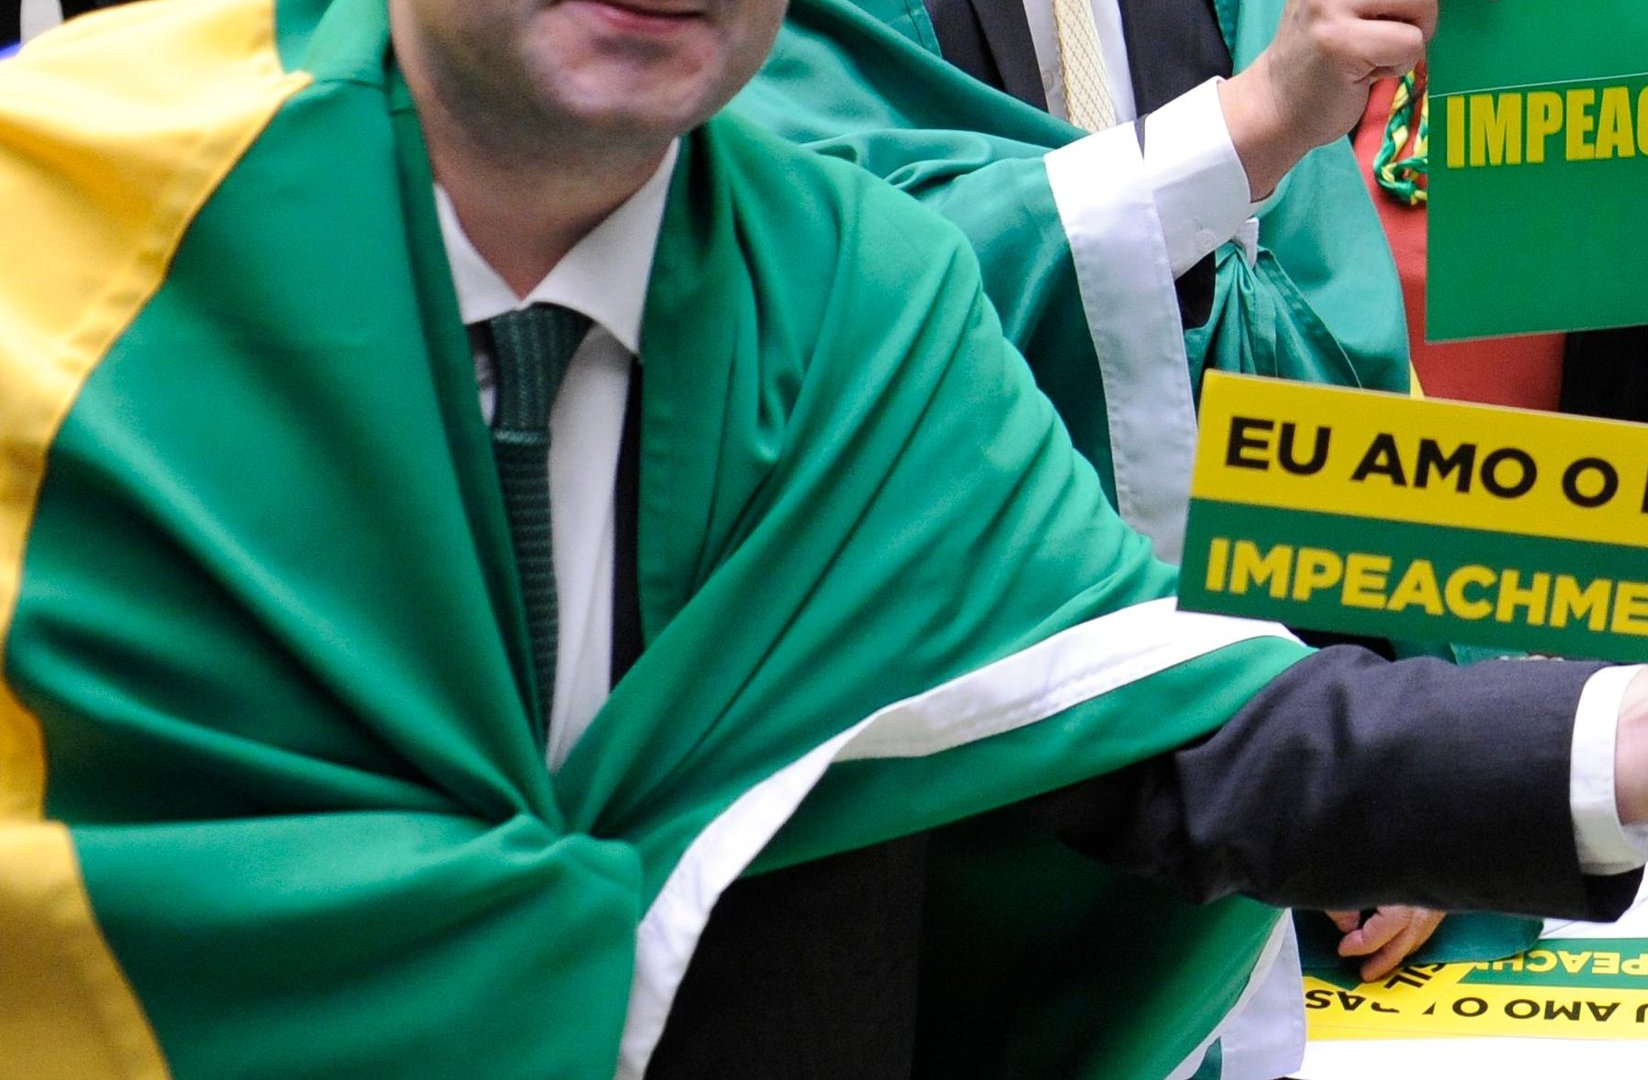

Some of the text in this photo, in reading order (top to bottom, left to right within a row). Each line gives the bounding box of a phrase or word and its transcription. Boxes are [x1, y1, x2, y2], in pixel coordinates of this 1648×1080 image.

[1224, 415, 1332, 476] EU
[1349, 432, 1538, 499] AMO
[1561, 456, 1619, 509] O
[1451, 996, 1489, 1017] O
[1503, 998, 1622, 1023] AMO
